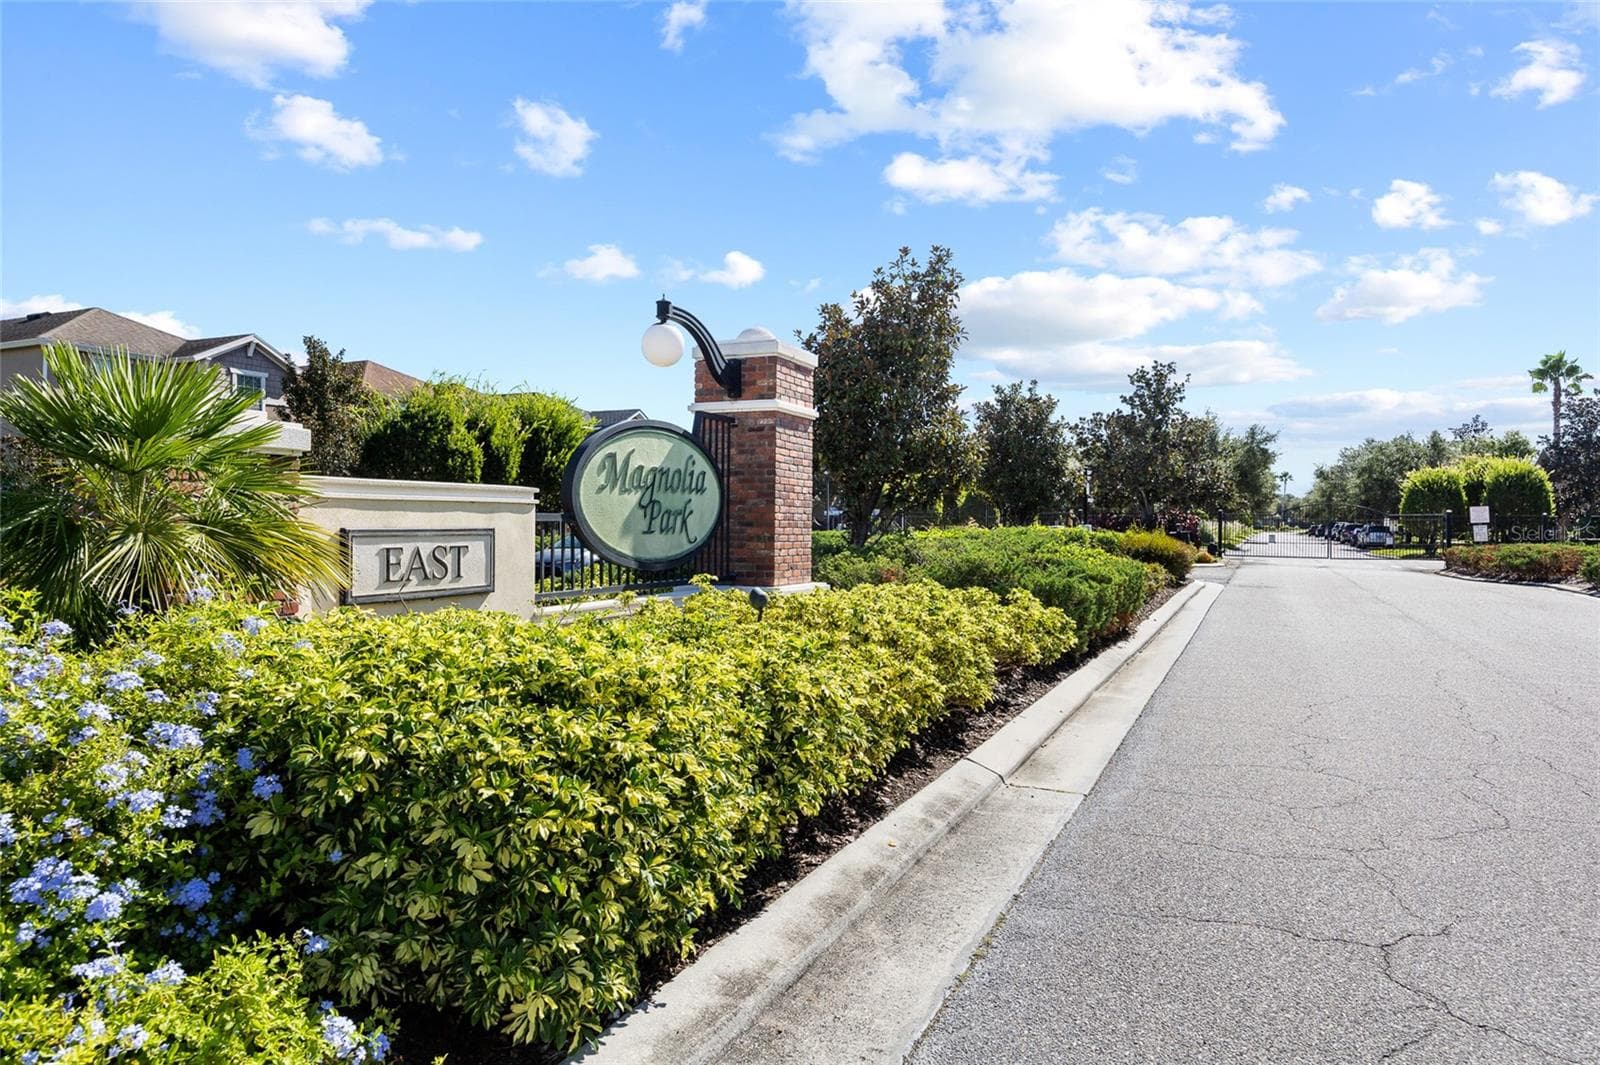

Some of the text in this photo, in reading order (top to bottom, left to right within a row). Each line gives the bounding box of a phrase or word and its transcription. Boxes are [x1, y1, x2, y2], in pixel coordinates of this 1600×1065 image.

[595, 448, 707, 508] Magnolia
[641, 499, 698, 544] Park
[382, 545, 469, 582] EAST
